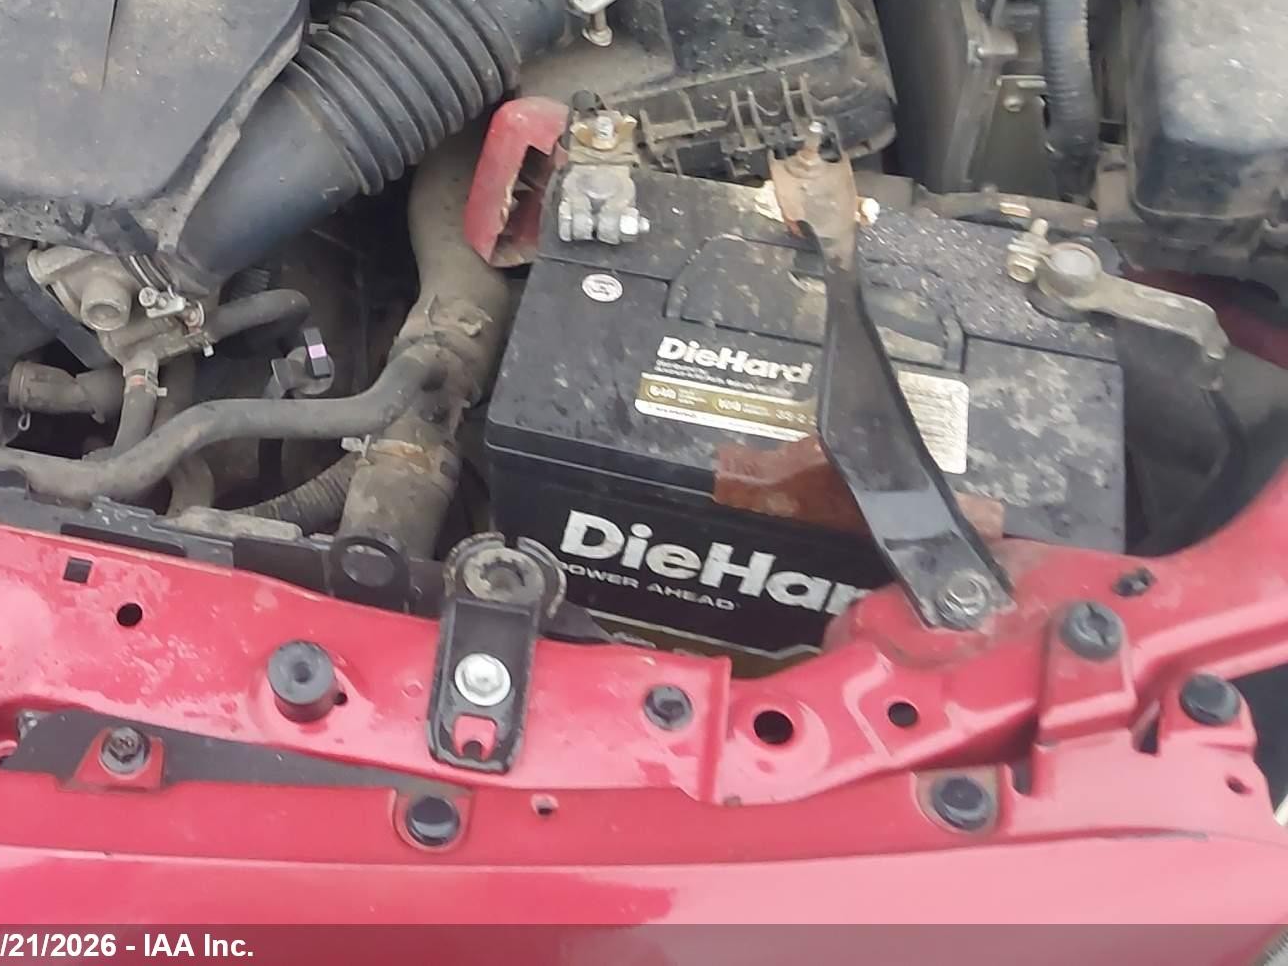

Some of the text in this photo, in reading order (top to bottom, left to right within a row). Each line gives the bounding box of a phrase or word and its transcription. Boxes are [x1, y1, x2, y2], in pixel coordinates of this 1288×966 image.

[656, 336, 813, 384] DieHard
[560, 510, 873, 615] DieHar
[646, 582, 735, 611] AHEAD
